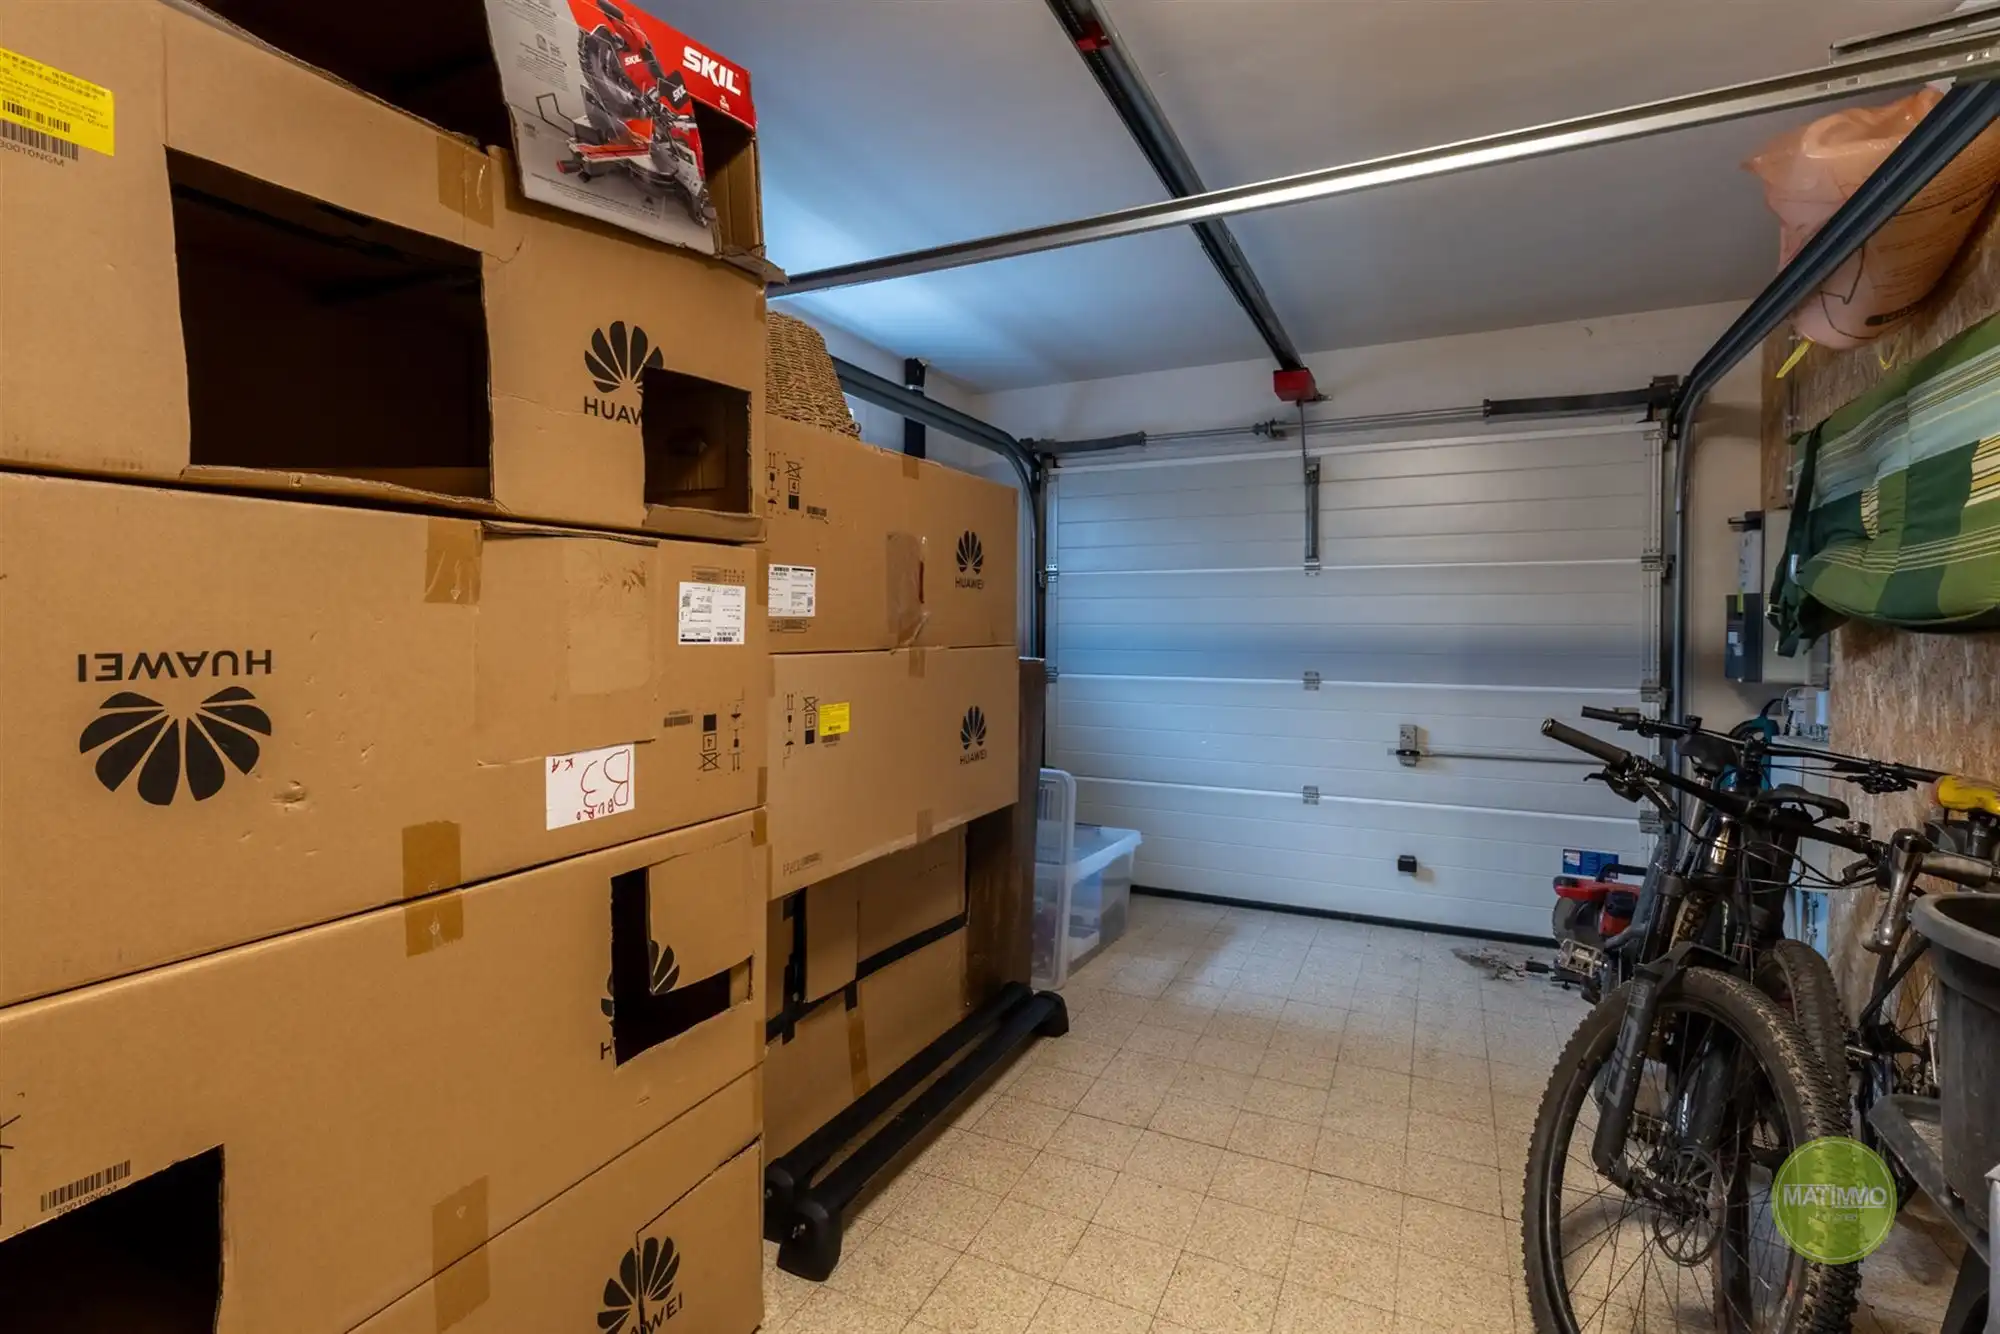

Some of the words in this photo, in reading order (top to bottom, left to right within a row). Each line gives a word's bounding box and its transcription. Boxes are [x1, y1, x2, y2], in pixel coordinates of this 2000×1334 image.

[624, 54, 643, 66] SKIL
[682, 45, 741, 96] SKIL
[584, 396, 643, 425] HUAW
[955, 576, 985, 590] HUAWEI
[78, 649, 272, 682] HUAWEI
[959, 749, 988, 765] HUAWEI
